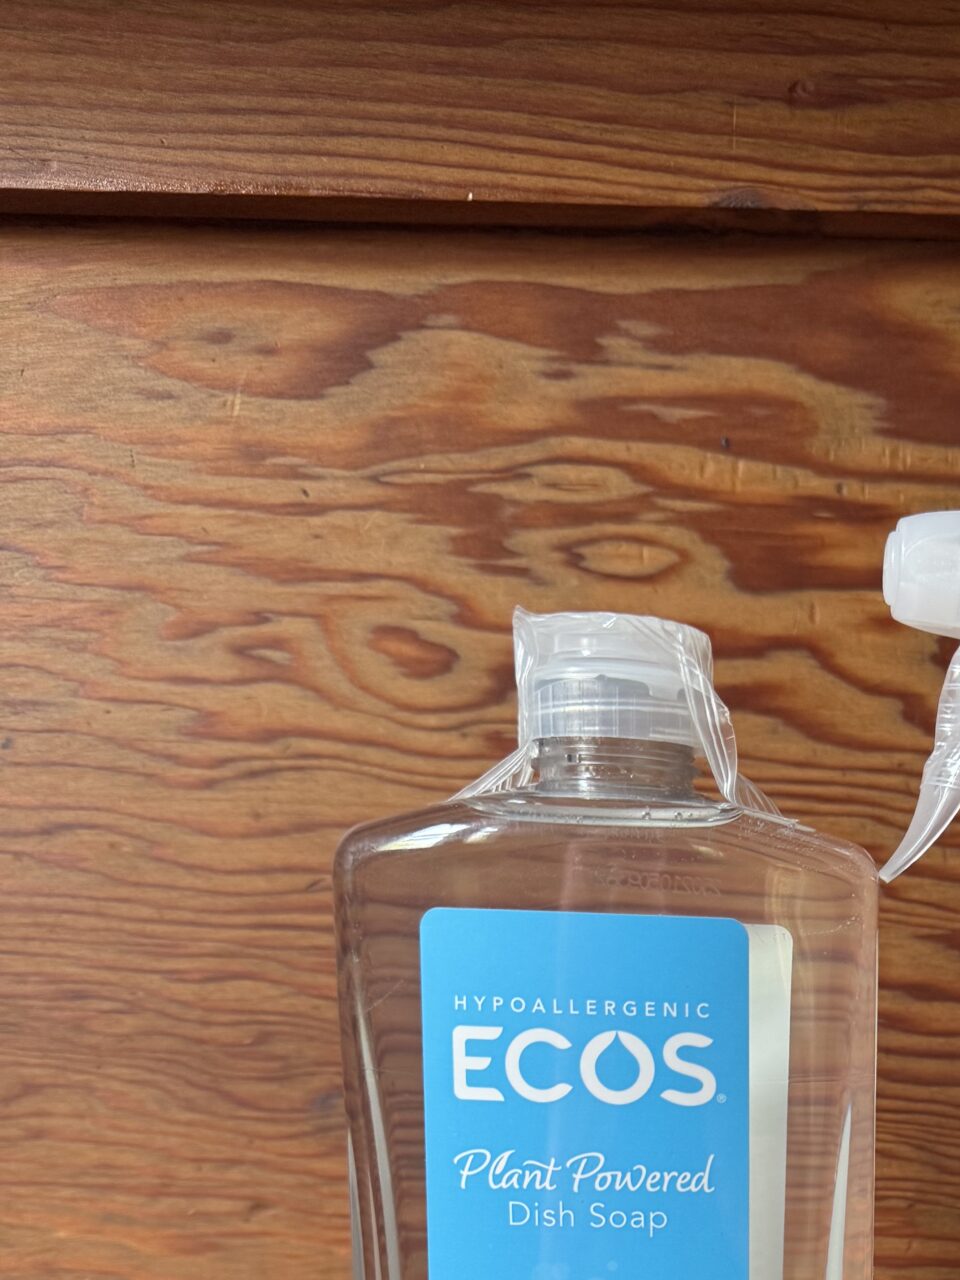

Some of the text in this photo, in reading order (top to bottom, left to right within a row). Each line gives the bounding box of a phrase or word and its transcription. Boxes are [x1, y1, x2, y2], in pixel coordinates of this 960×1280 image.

[453, 994, 711, 1019] HYPOALLERGENIC
[452, 1148, 715, 1193] Plant Powered
[508, 1200, 669, 1238] Dish Soap
